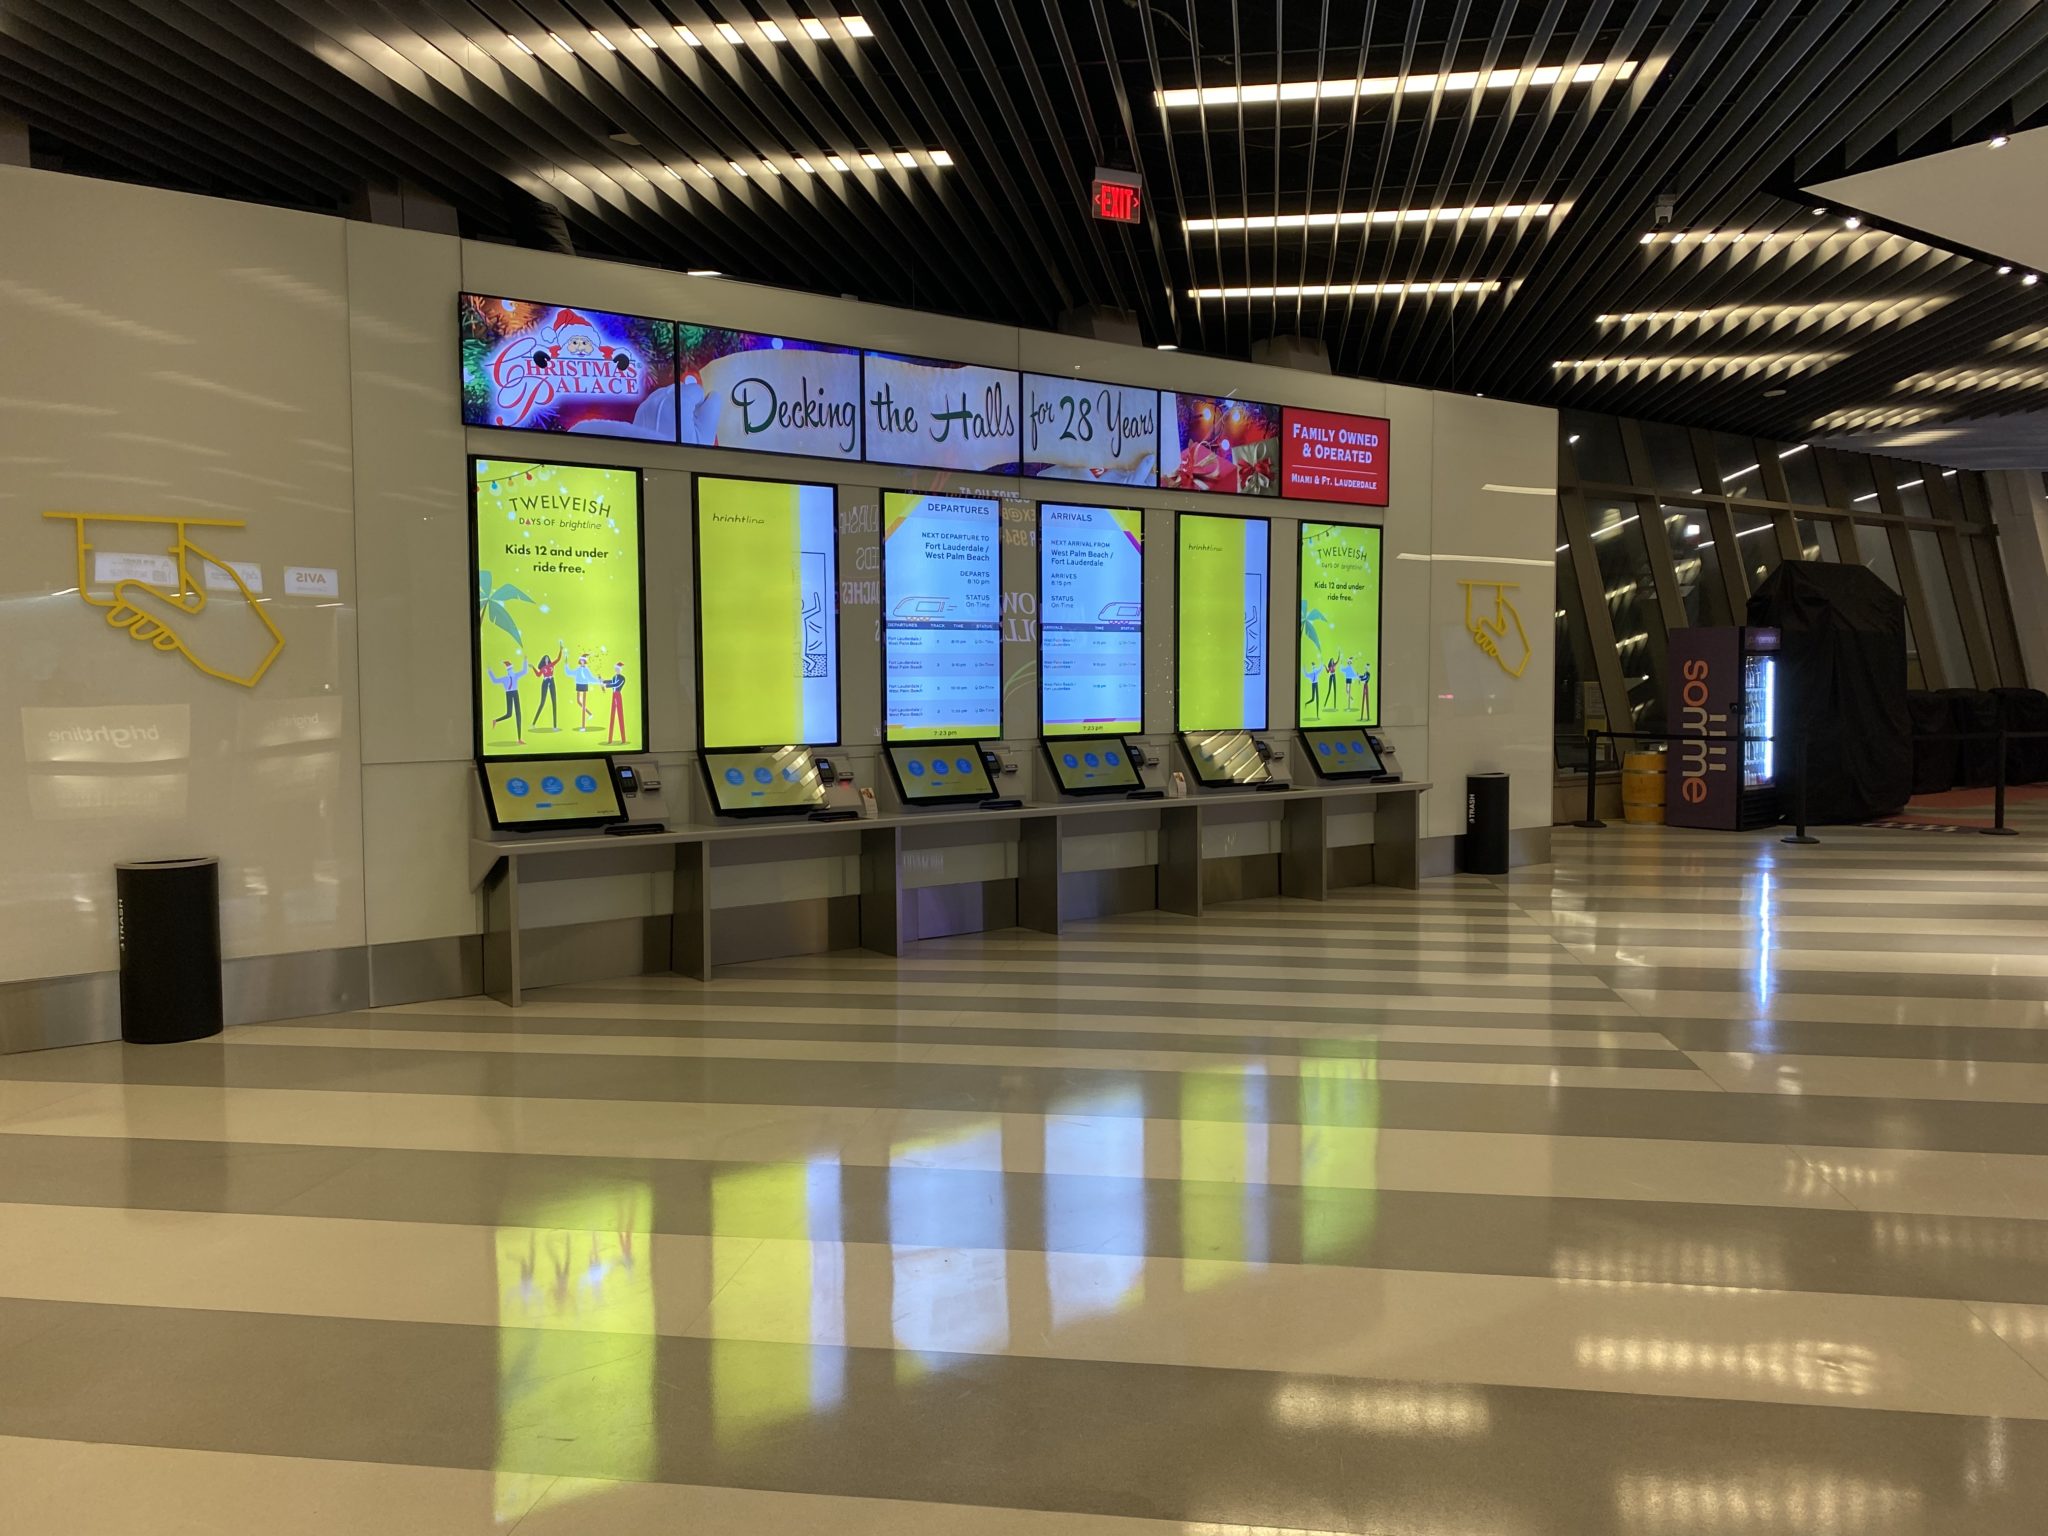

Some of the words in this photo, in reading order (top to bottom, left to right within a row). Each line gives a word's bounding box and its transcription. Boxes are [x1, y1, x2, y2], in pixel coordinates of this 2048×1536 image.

[1101, 184, 1133, 219] EXIT
[485, 337, 638, 388] CHRISTMAS
[497, 376, 639, 426] PALACE
[731, 376, 856, 452] Decking
[870, 382, 918, 433] the
[929, 381, 1014, 442] Halls
[1030, 390, 1055, 451] for
[1059, 395, 1093, 442] 28
[1097, 389, 1154, 458] Years
[1303, 443, 1312, 458] &
[509, 495, 611, 518] TWELVEISH
[928, 503, 990, 515] DEPARTURES
[1051, 512, 1092, 522] ARRIVALS
[544, 518, 556, 526] OF
[560, 519, 602, 532] brightline
[941, 533, 979, 541] DEPARTURE
[505, 544, 531, 555] Kids
[535, 545, 547, 556] 12
[550, 546, 572, 557] and
[576, 547, 609, 559] under
[925, 542, 941, 550] Fort
[942, 543, 984, 552] Lauderdale
[1051, 549, 1069, 557] West
[925, 552, 945, 560] West
[946, 552, 965, 560] Palm
[966, 553, 990, 562] Beach
[1317, 546, 1368, 562] TWELVEISH
[533, 562, 556, 573] ride
[559, 562, 586, 574] free.
[1066, 558, 1104, 567] Lauderdale
[1314, 581, 1327, 589] Kids
[1329, 581, 1335, 589] 12
[1336, 582, 1347, 590] and
[1348, 582, 1365, 590] under
[1327, 593, 1339, 601] ride
